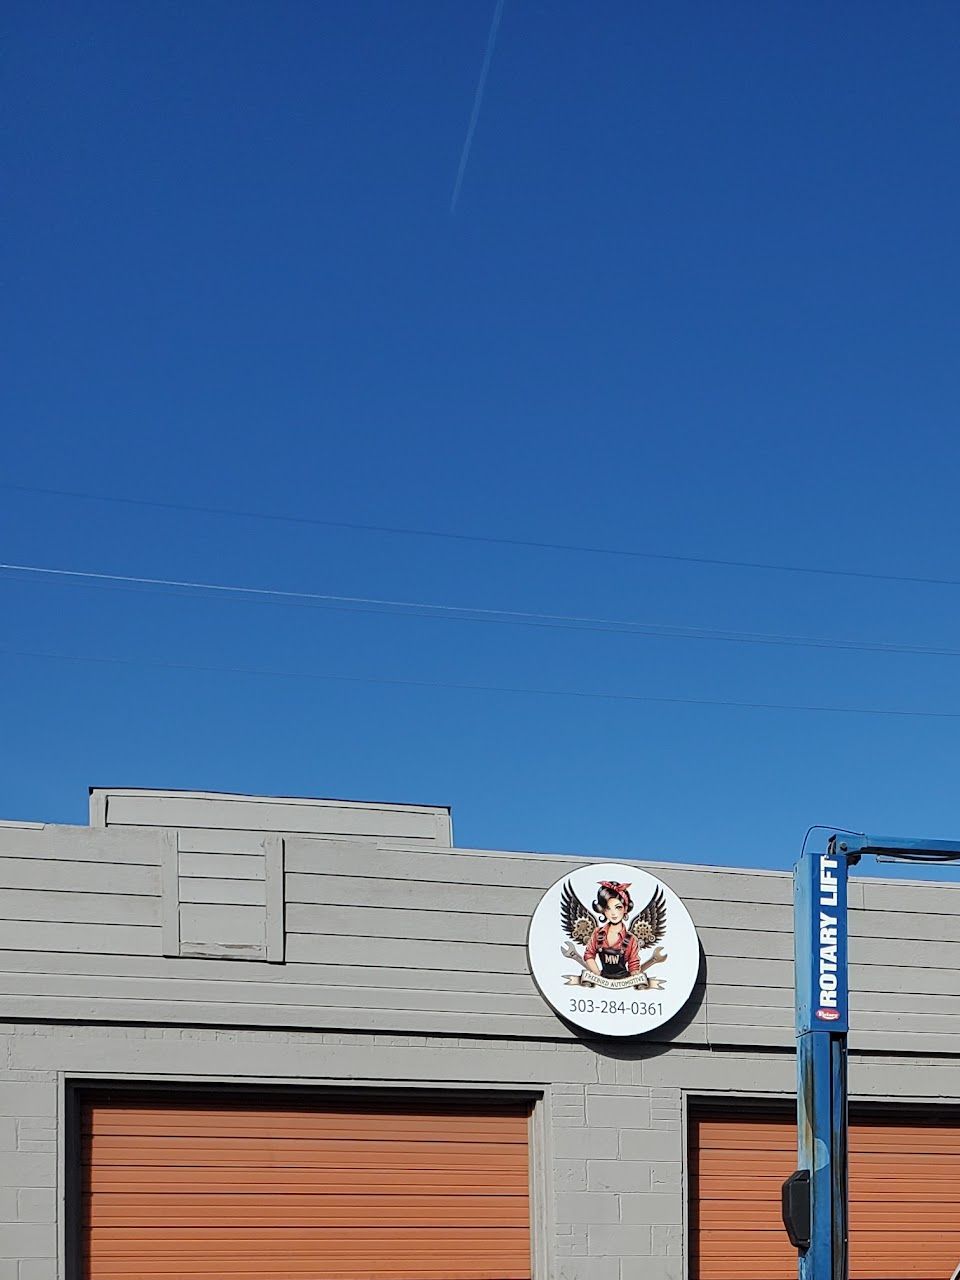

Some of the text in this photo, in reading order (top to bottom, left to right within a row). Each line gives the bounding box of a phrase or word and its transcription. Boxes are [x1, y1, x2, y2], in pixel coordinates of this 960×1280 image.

[819, 854, 838, 1008] ROTARY LIFT
[604, 953, 620, 965] MW
[610, 975, 645, 988] AUTOMOTIVE
[569, 998, 663, 1016] 303-284-0361
